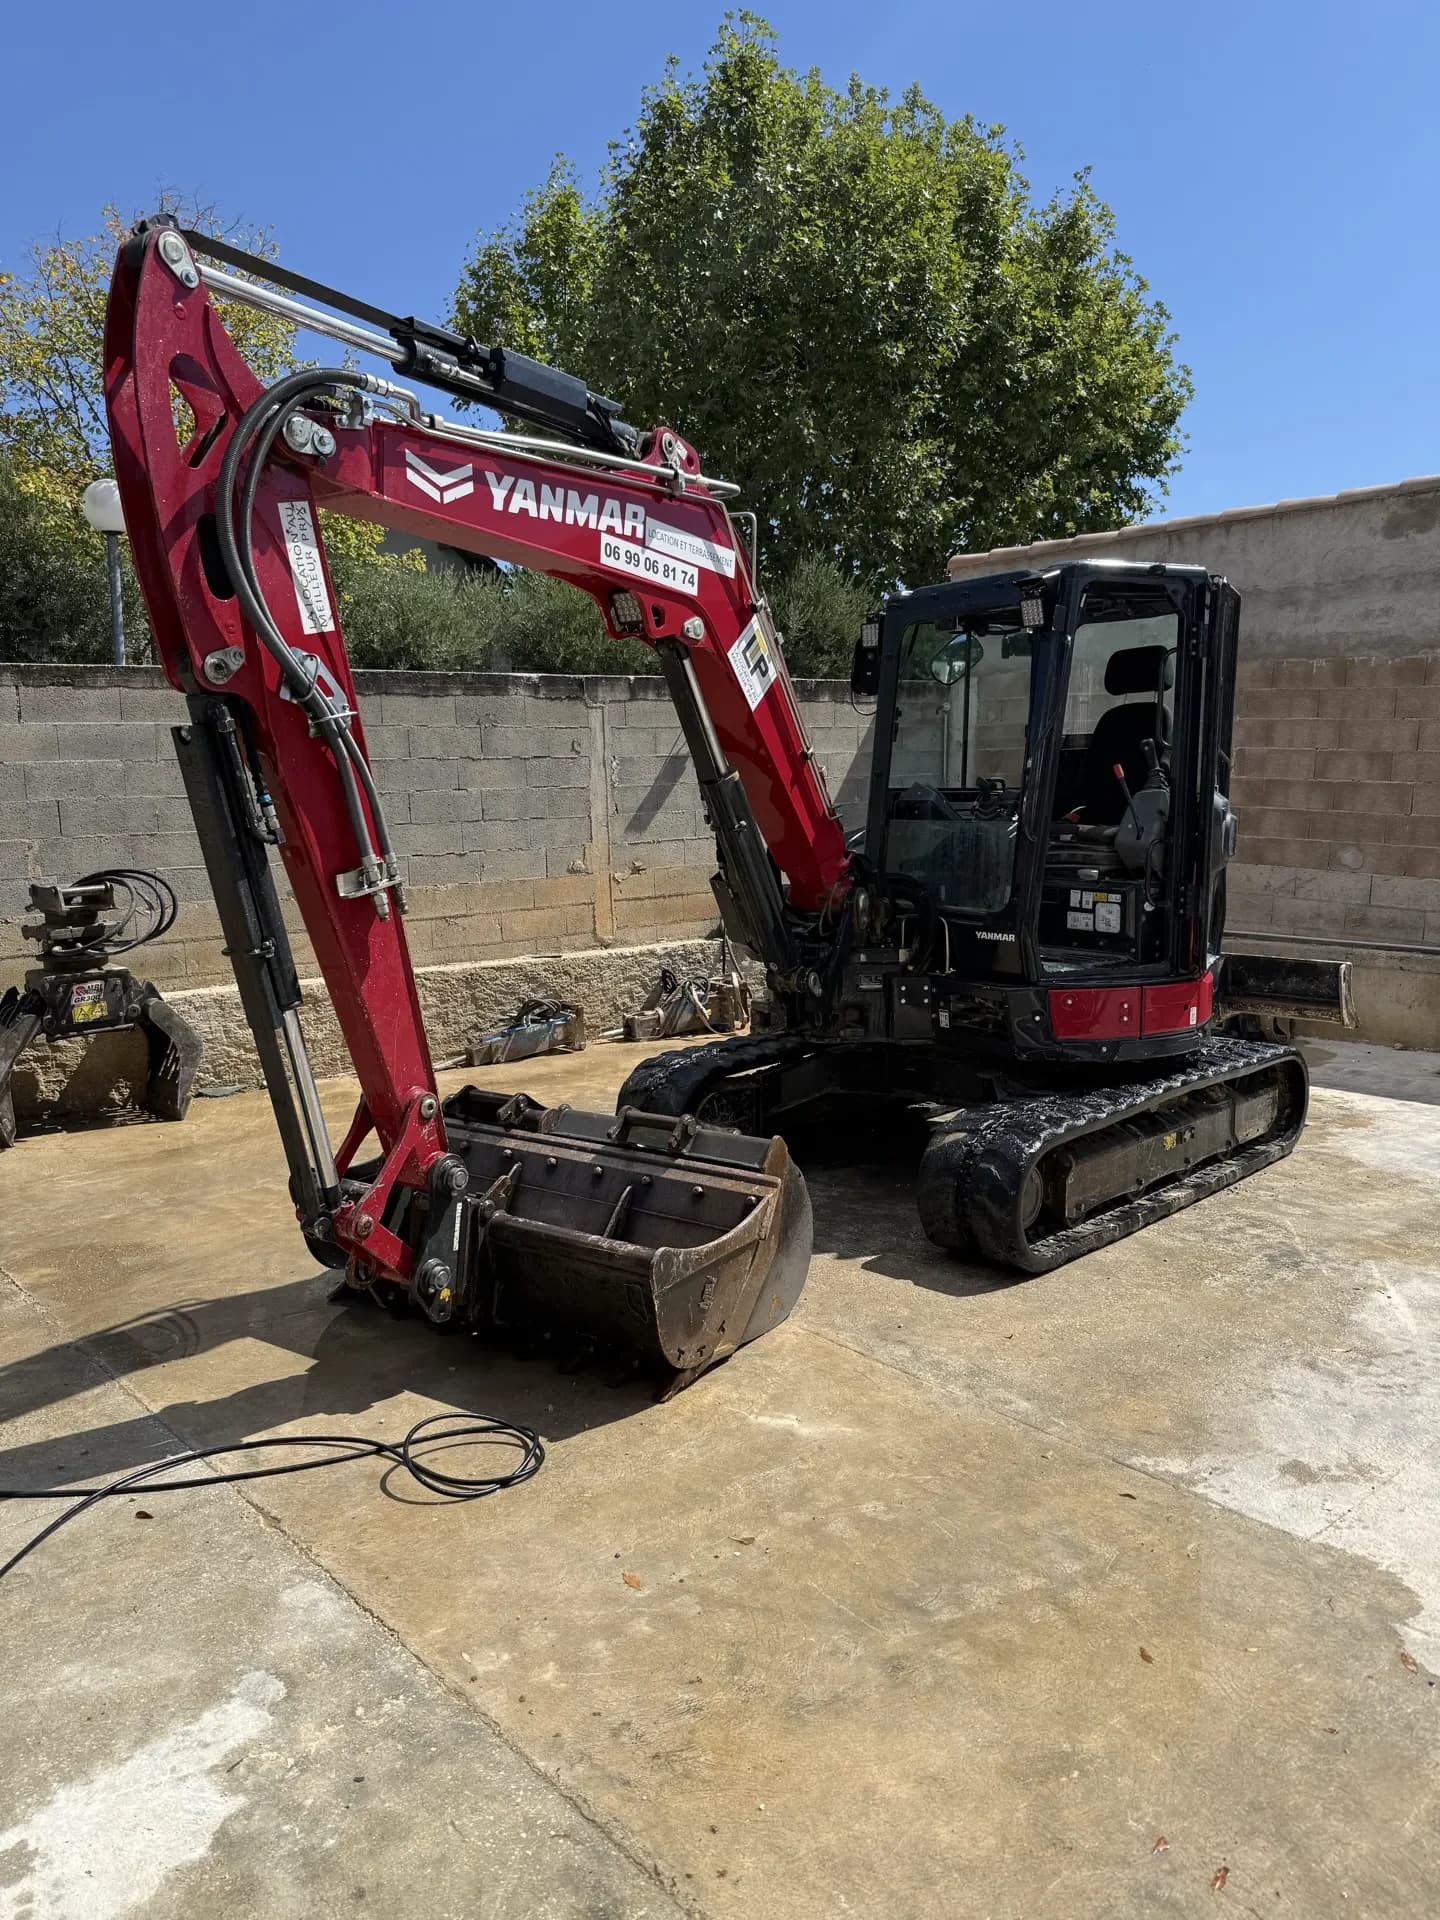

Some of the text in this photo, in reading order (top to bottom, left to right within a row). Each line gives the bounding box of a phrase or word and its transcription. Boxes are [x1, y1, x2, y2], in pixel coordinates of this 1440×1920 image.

[484, 470, 647, 539] YANMAR
[297, 506, 328, 627] MEILLEUR PRIX
[604, 542, 695, 588] 06 99 06 81 74
[648, 528, 733, 569] LOCATION ET TERRASSEMENT
[309, 611, 317, 630] LA
[975, 930, 1016, 942] YANMAR
